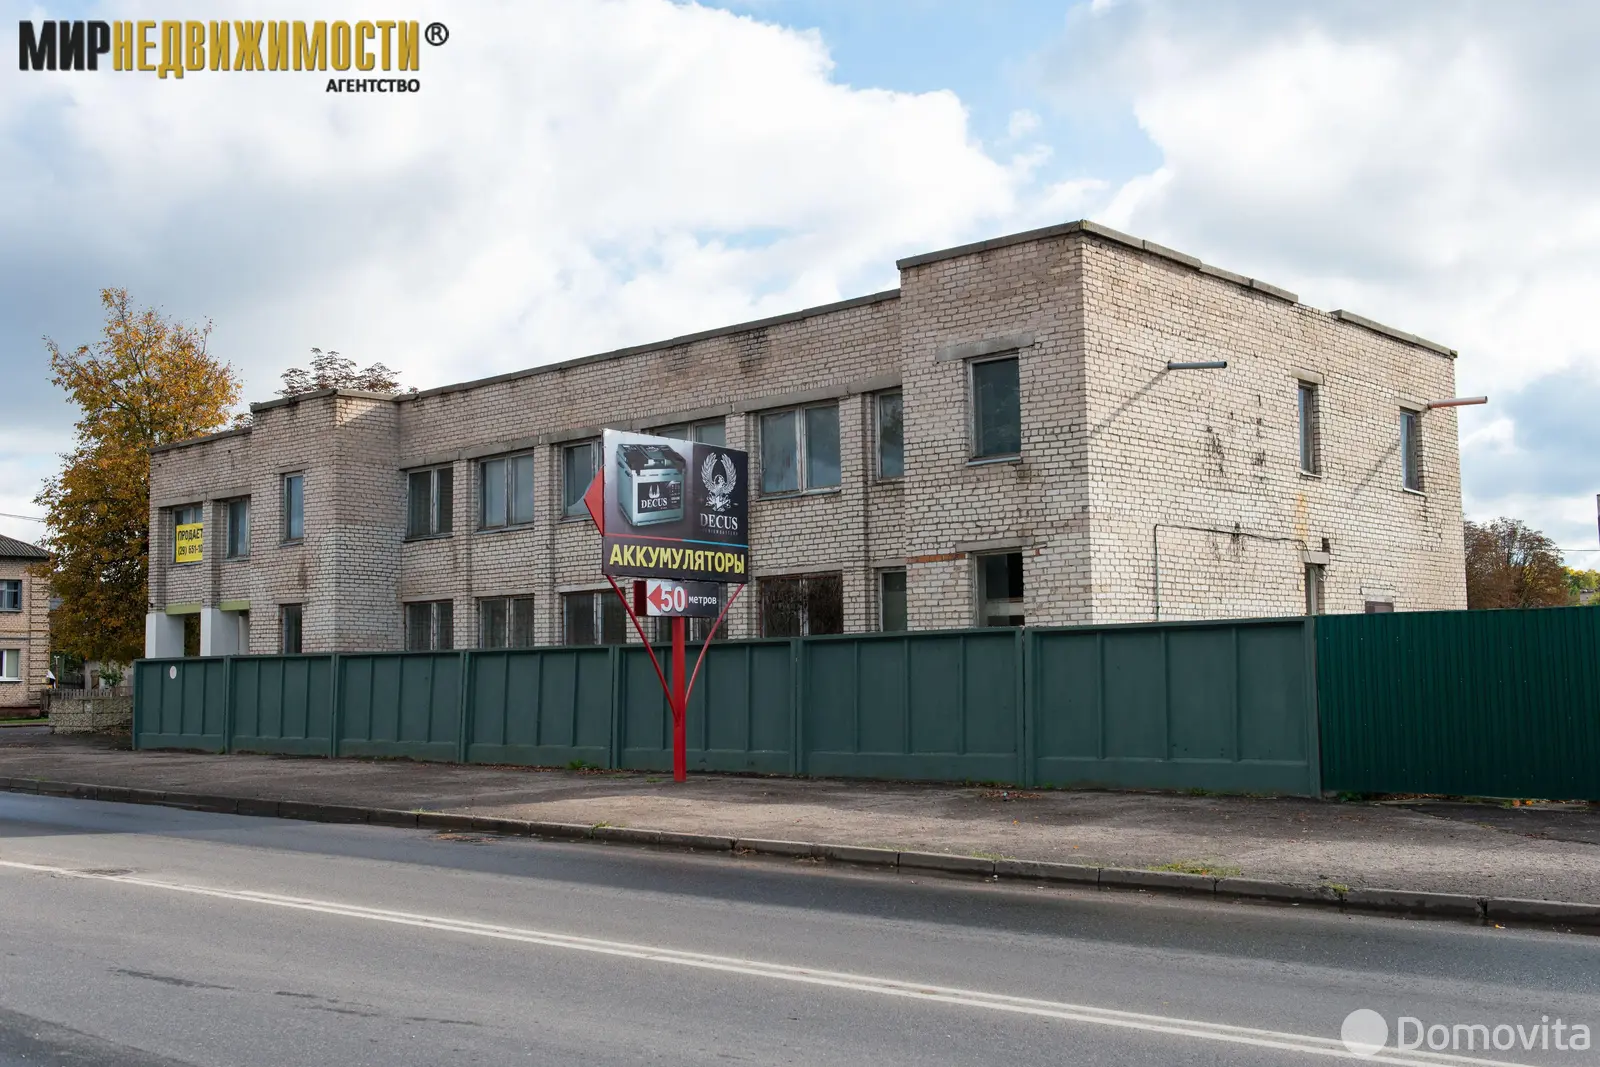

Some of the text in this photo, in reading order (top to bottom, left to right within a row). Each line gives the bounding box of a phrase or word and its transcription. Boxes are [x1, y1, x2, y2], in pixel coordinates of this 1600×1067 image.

[641, 497, 668, 509] DECUS
[700, 512, 738, 530] DECUS
[609, 543, 745, 574] АККУМУЛЯТОРЫ
[660, 586, 718, 613] 50 метров
